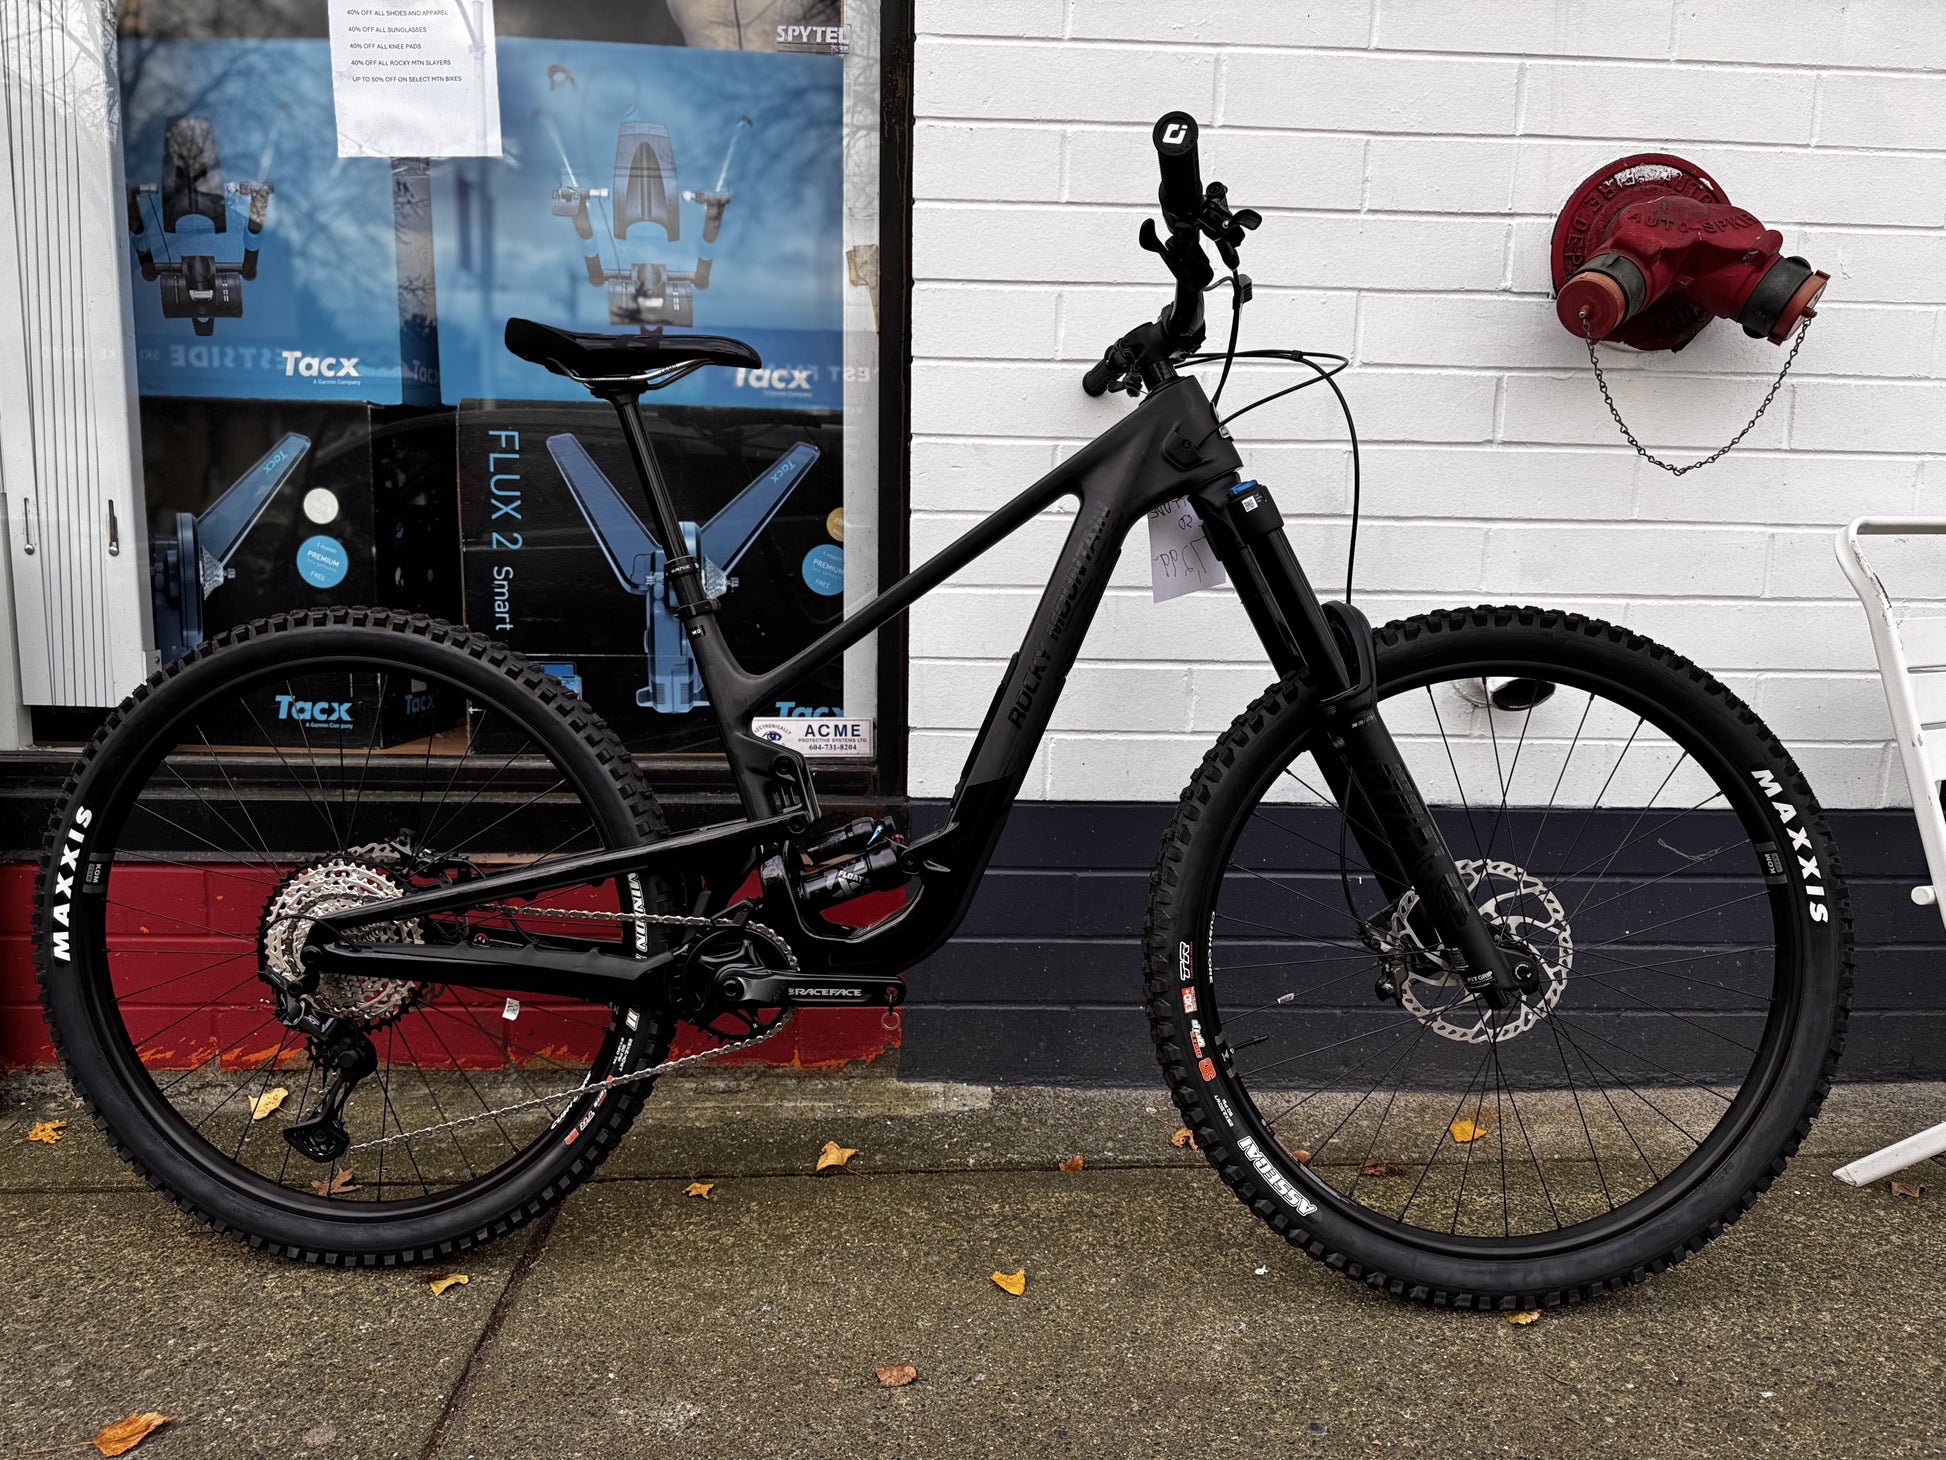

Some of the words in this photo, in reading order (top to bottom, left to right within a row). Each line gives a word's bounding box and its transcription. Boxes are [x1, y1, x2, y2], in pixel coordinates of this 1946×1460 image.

[281, 350, 360, 377] Tacx
[262, 450, 288, 474] Tacx
[770, 460, 796, 484] Tacx
[488, 429, 522, 520] FLUX
[492, 532, 523, 550] 2
[307, 550, 340, 568] PREMIUM
[310, 570, 326, 582] FREE
[815, 579, 831, 589] FREE
[493, 566, 514, 630] Smart
[1007, 640, 1051, 730] ROCKY
[1046, 501, 1112, 643] MOUNTAIN
[275, 695, 353, 721] Tacx
[404, 693, 434, 715] Tacx
[754, 723, 792, 735] LECTRONICALLY
[804, 724, 861, 737] ACME
[1750, 769, 1829, 923] MAXXIS
[93, 863, 102, 883] KOM
[1765, 853, 1776, 874] KOM
[53, 805, 93, 962] MAXXIS
[837, 870, 864, 883] FLOAT
[1179, 941, 1190, 981] TR
[1237, 1135, 1318, 1217] ASSEGAI
